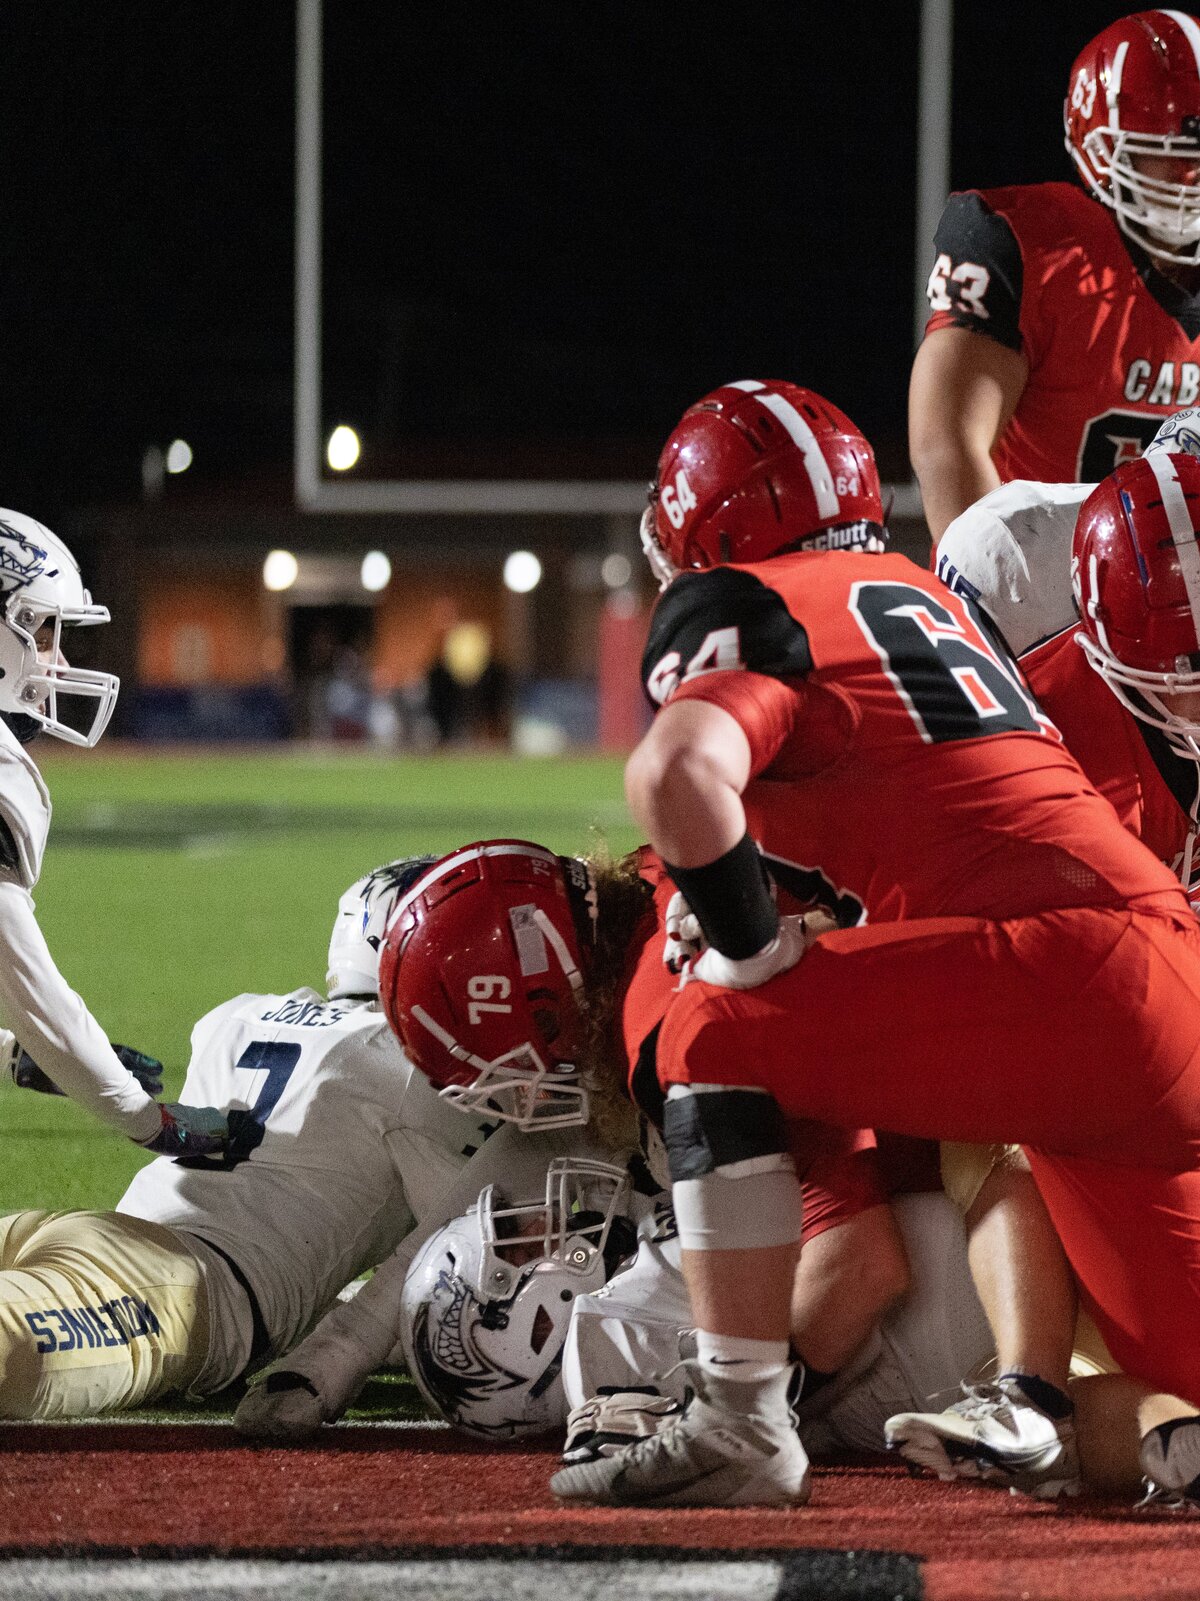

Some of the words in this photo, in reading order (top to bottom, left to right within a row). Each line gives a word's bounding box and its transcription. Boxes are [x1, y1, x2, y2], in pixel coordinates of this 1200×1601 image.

[926, 254, 990, 319] 63
[661, 469, 697, 529] 64
[836, 476, 859, 497] 64
[801, 519, 868, 551] schutt
[468, 975, 512, 1026] 79
